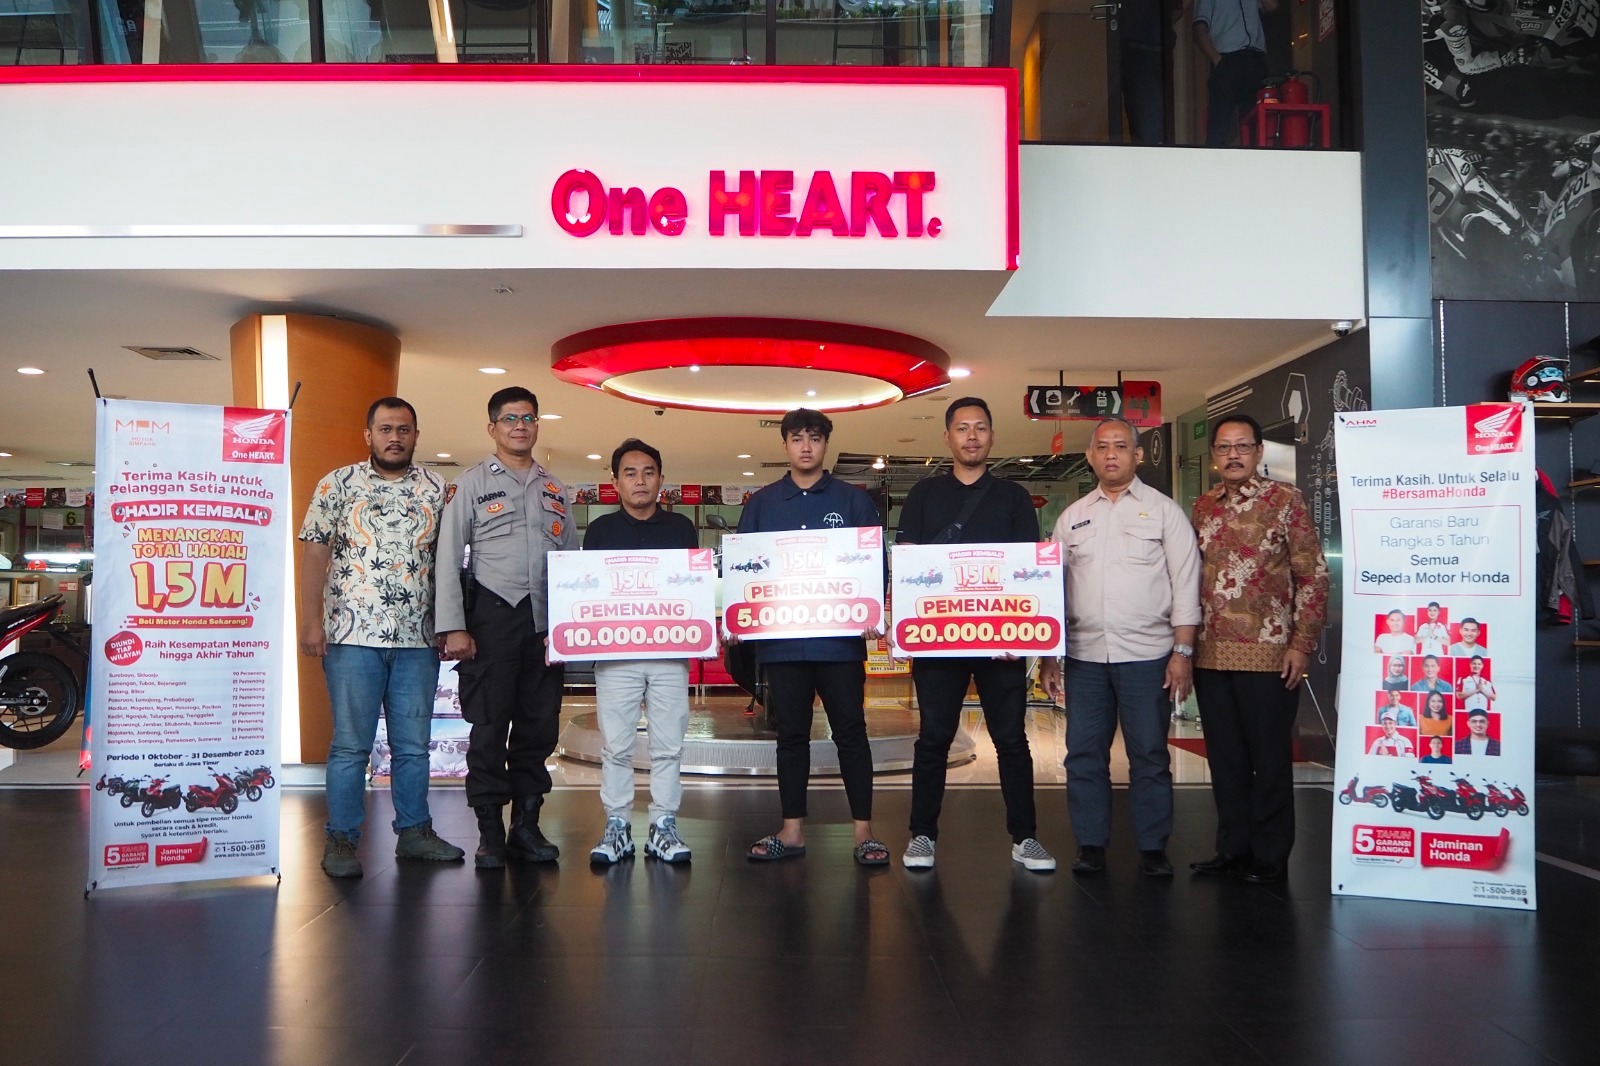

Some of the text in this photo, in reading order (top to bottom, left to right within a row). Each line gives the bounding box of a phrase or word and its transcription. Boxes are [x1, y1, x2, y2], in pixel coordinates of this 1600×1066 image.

[1554, 0, 1578, 30] REP
[551, 168, 942, 238] One HEART.
[115, 419, 170, 434] MPM
[232, 451, 275, 460] One HEART.
[122, 471, 262, 487] Terima Kasih untuk
[1351, 471, 1520, 487] Terima Kasih. Untuk Selalu
[110, 482, 274, 500] Pelanggan Setia Honda
[477, 491, 506, 504] DARNO
[1382, 486, 1486, 500] #BersamaHonda
[66, 511, 76, 526] 6
[125, 504, 261, 521] HADIR KEMBALI
[1390, 516, 1479, 529] Garansi Baru
[138, 527, 243, 544] MENANGKAN
[1380, 534, 1490, 550] Rangka 5 Tahun
[132, 544, 247, 560] TOTAL HADIAH
[1410, 554, 1459, 566] Semua
[1361, 571, 1510, 586] Sepeda Motor Honda
[130, 561, 247, 613] 1,5 M
[751, 582, 853, 599] PEMENANG
[580, 603, 685, 619] PEMENANG
[923, 599, 1032, 614] PEMENANG
[737, 603, 869, 628] 5.000.000
[564, 625, 702, 648] 10.000.000
[905, 622, 1052, 644] 20.000.000
[110, 638, 135, 649] DIUNDI
[116, 646, 132, 654] TIAP
[169, 640, 230, 650] Kesempatan
[232, 640, 269, 649] Menang
[110, 650, 142, 662] WILAYAH
[159, 650, 193, 660] hingga
[202, 750, 243, 759] Desember
[222, 843, 266, 852] 1-500-989
[1355, 828, 1375, 852] 5
[1376, 839, 1411, 847] GARANSI
[1429, 838, 1483, 851] Jaminan
[107, 847, 121, 864] 5
[1430, 851, 1471, 862] Honda
[1481, 886, 1527, 895] 1-500-989
